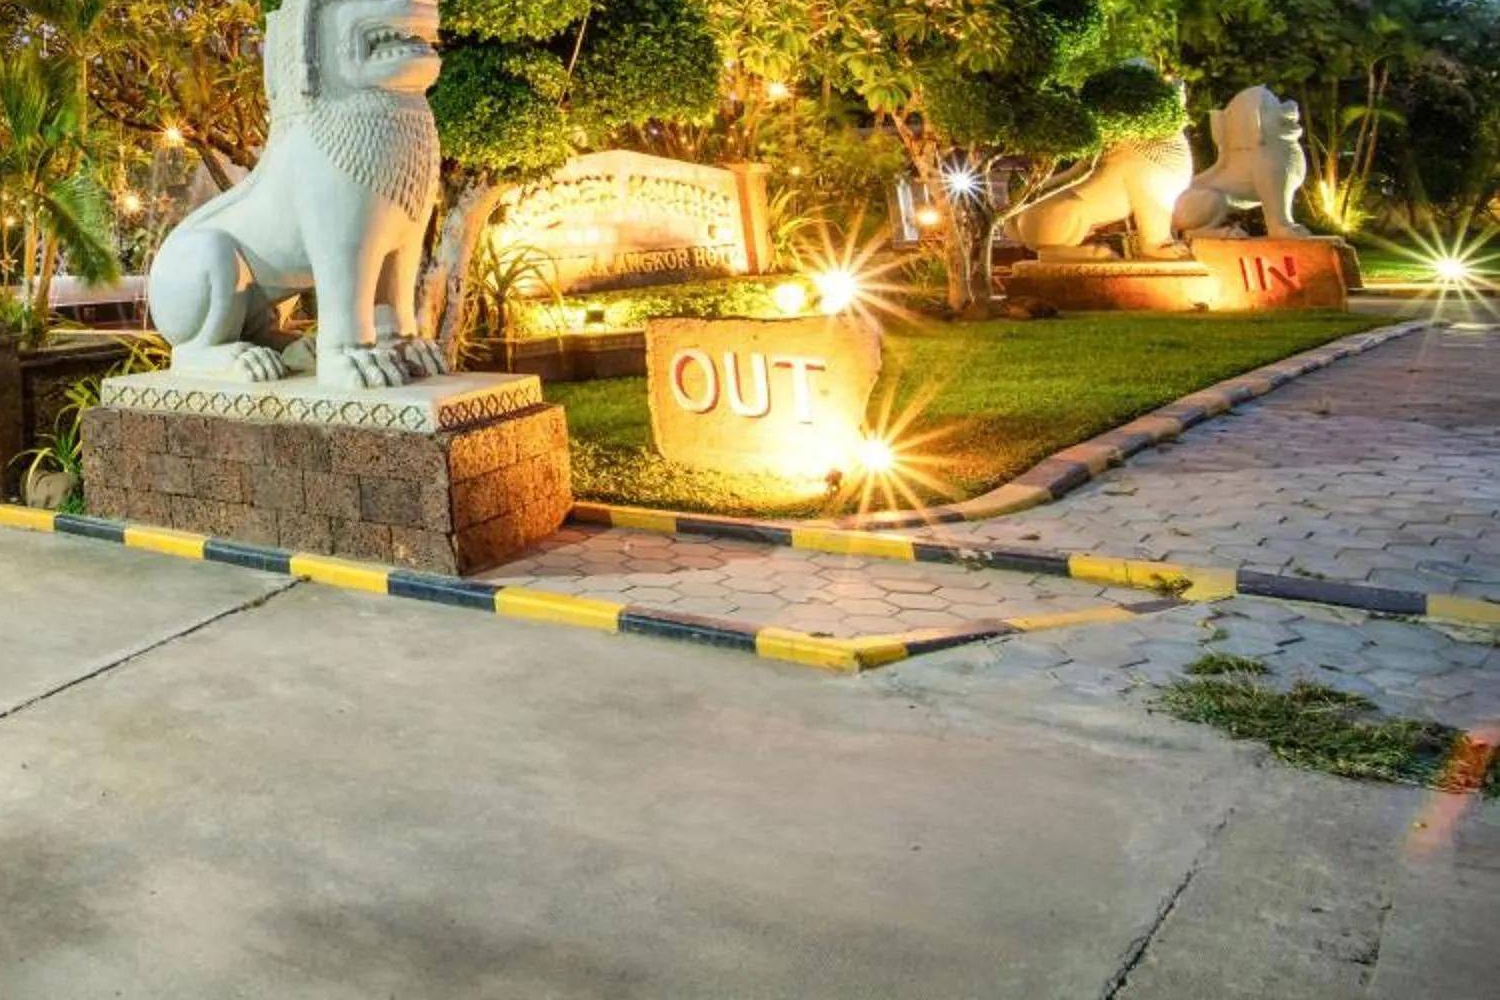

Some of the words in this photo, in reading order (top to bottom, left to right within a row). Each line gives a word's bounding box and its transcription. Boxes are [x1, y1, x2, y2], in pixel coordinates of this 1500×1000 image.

[615, 249, 691, 275] ANGKOR
[1238, 255, 1302, 293] IN
[670, 346, 828, 425] OUT
